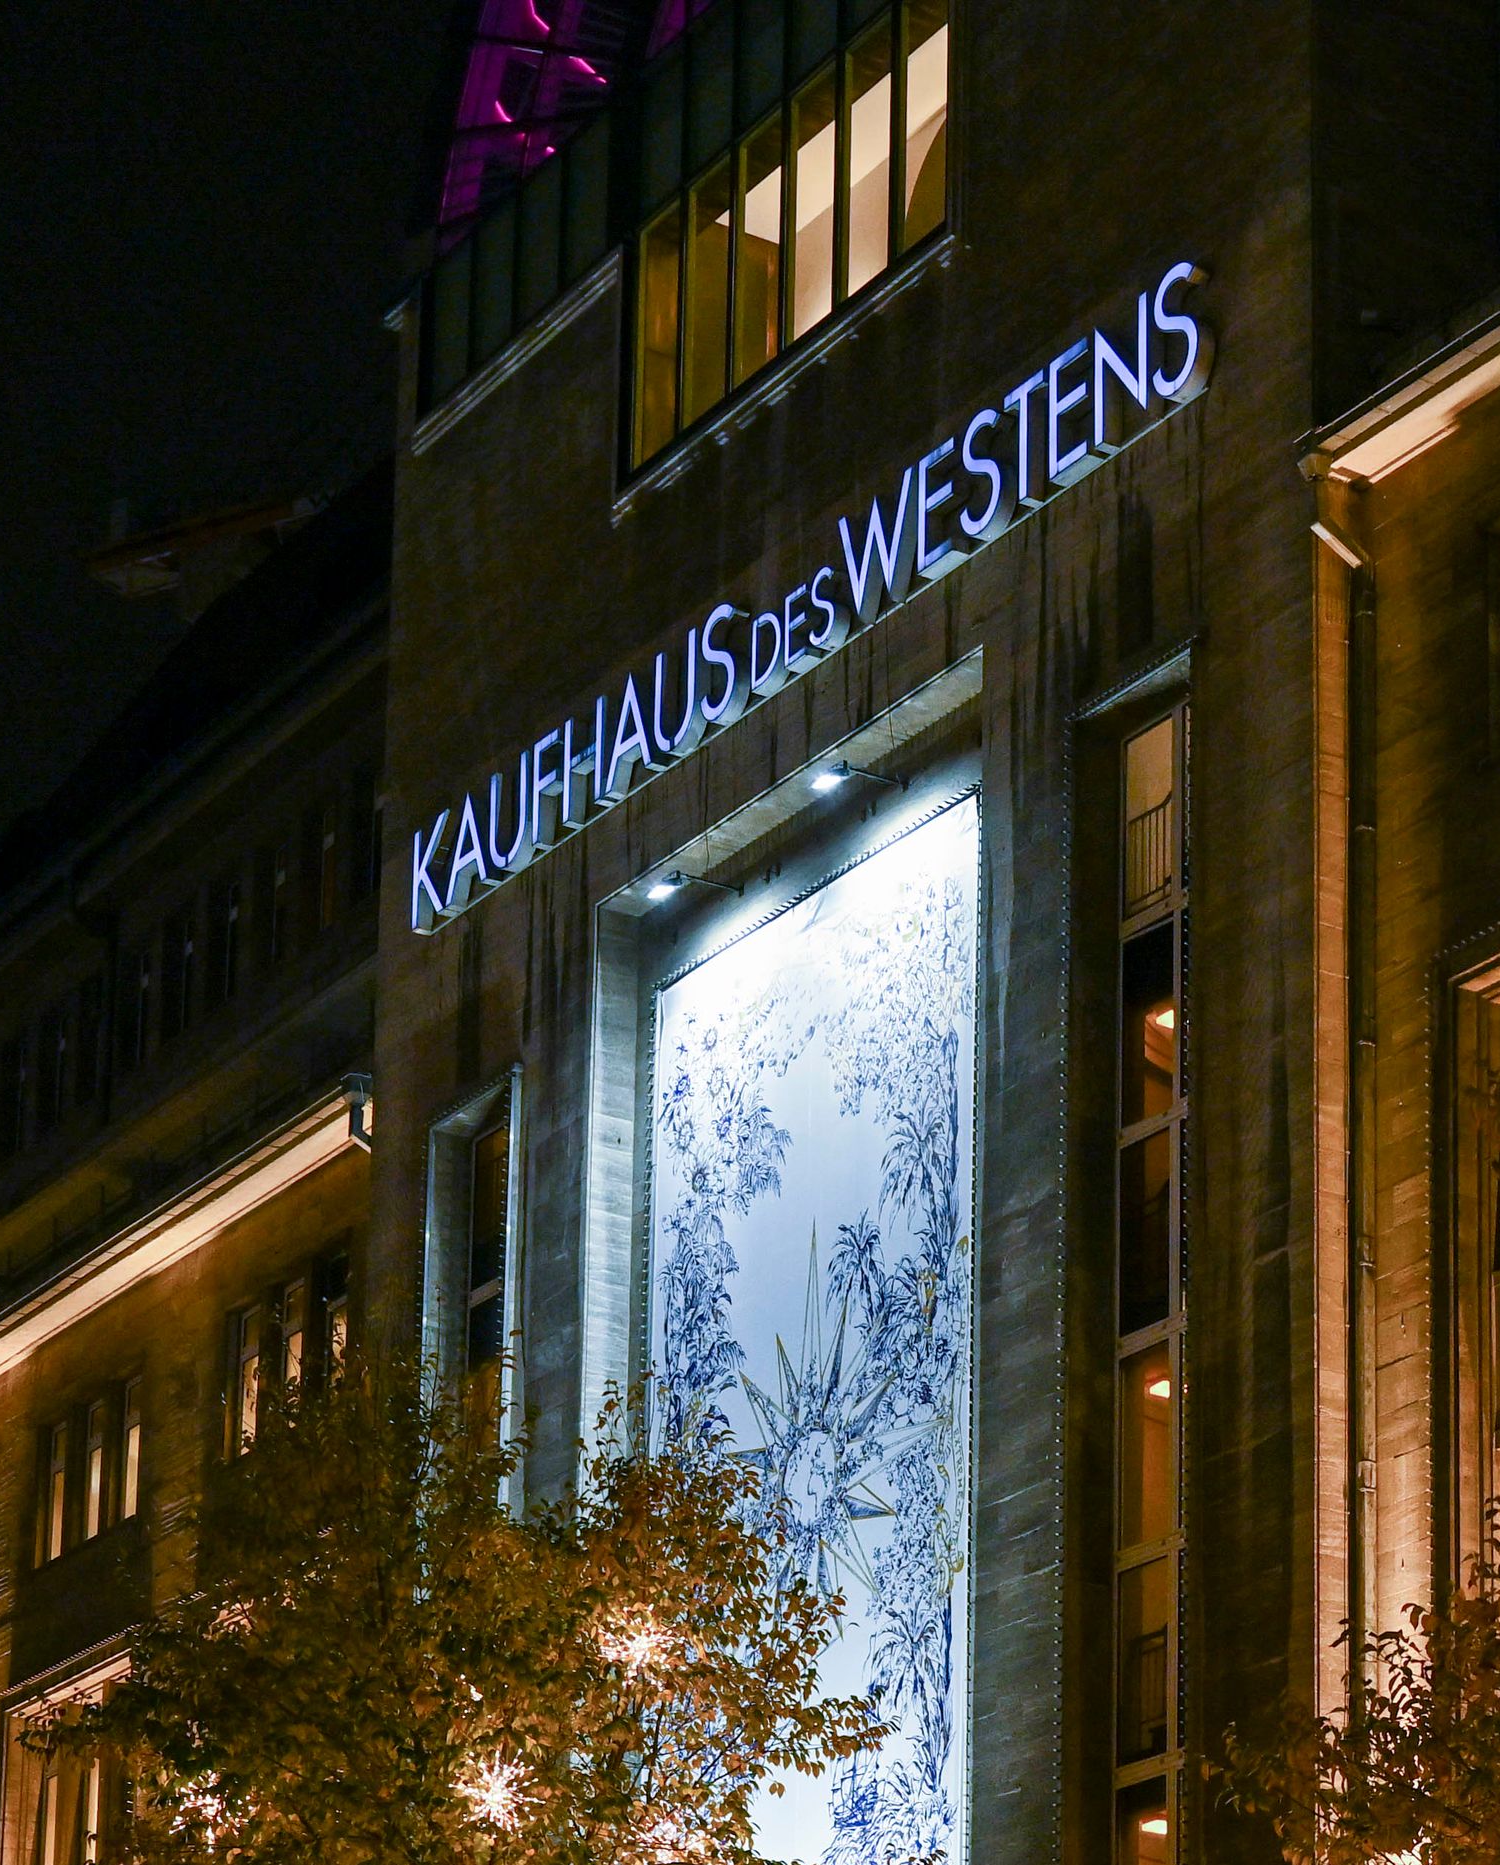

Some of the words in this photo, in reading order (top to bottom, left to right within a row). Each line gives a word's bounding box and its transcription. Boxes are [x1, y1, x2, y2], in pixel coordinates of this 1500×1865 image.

[411, 603, 741, 934] KAUFHAUS
[750, 566, 837, 696] DES
[838, 261, 1206, 616] WESTENS
